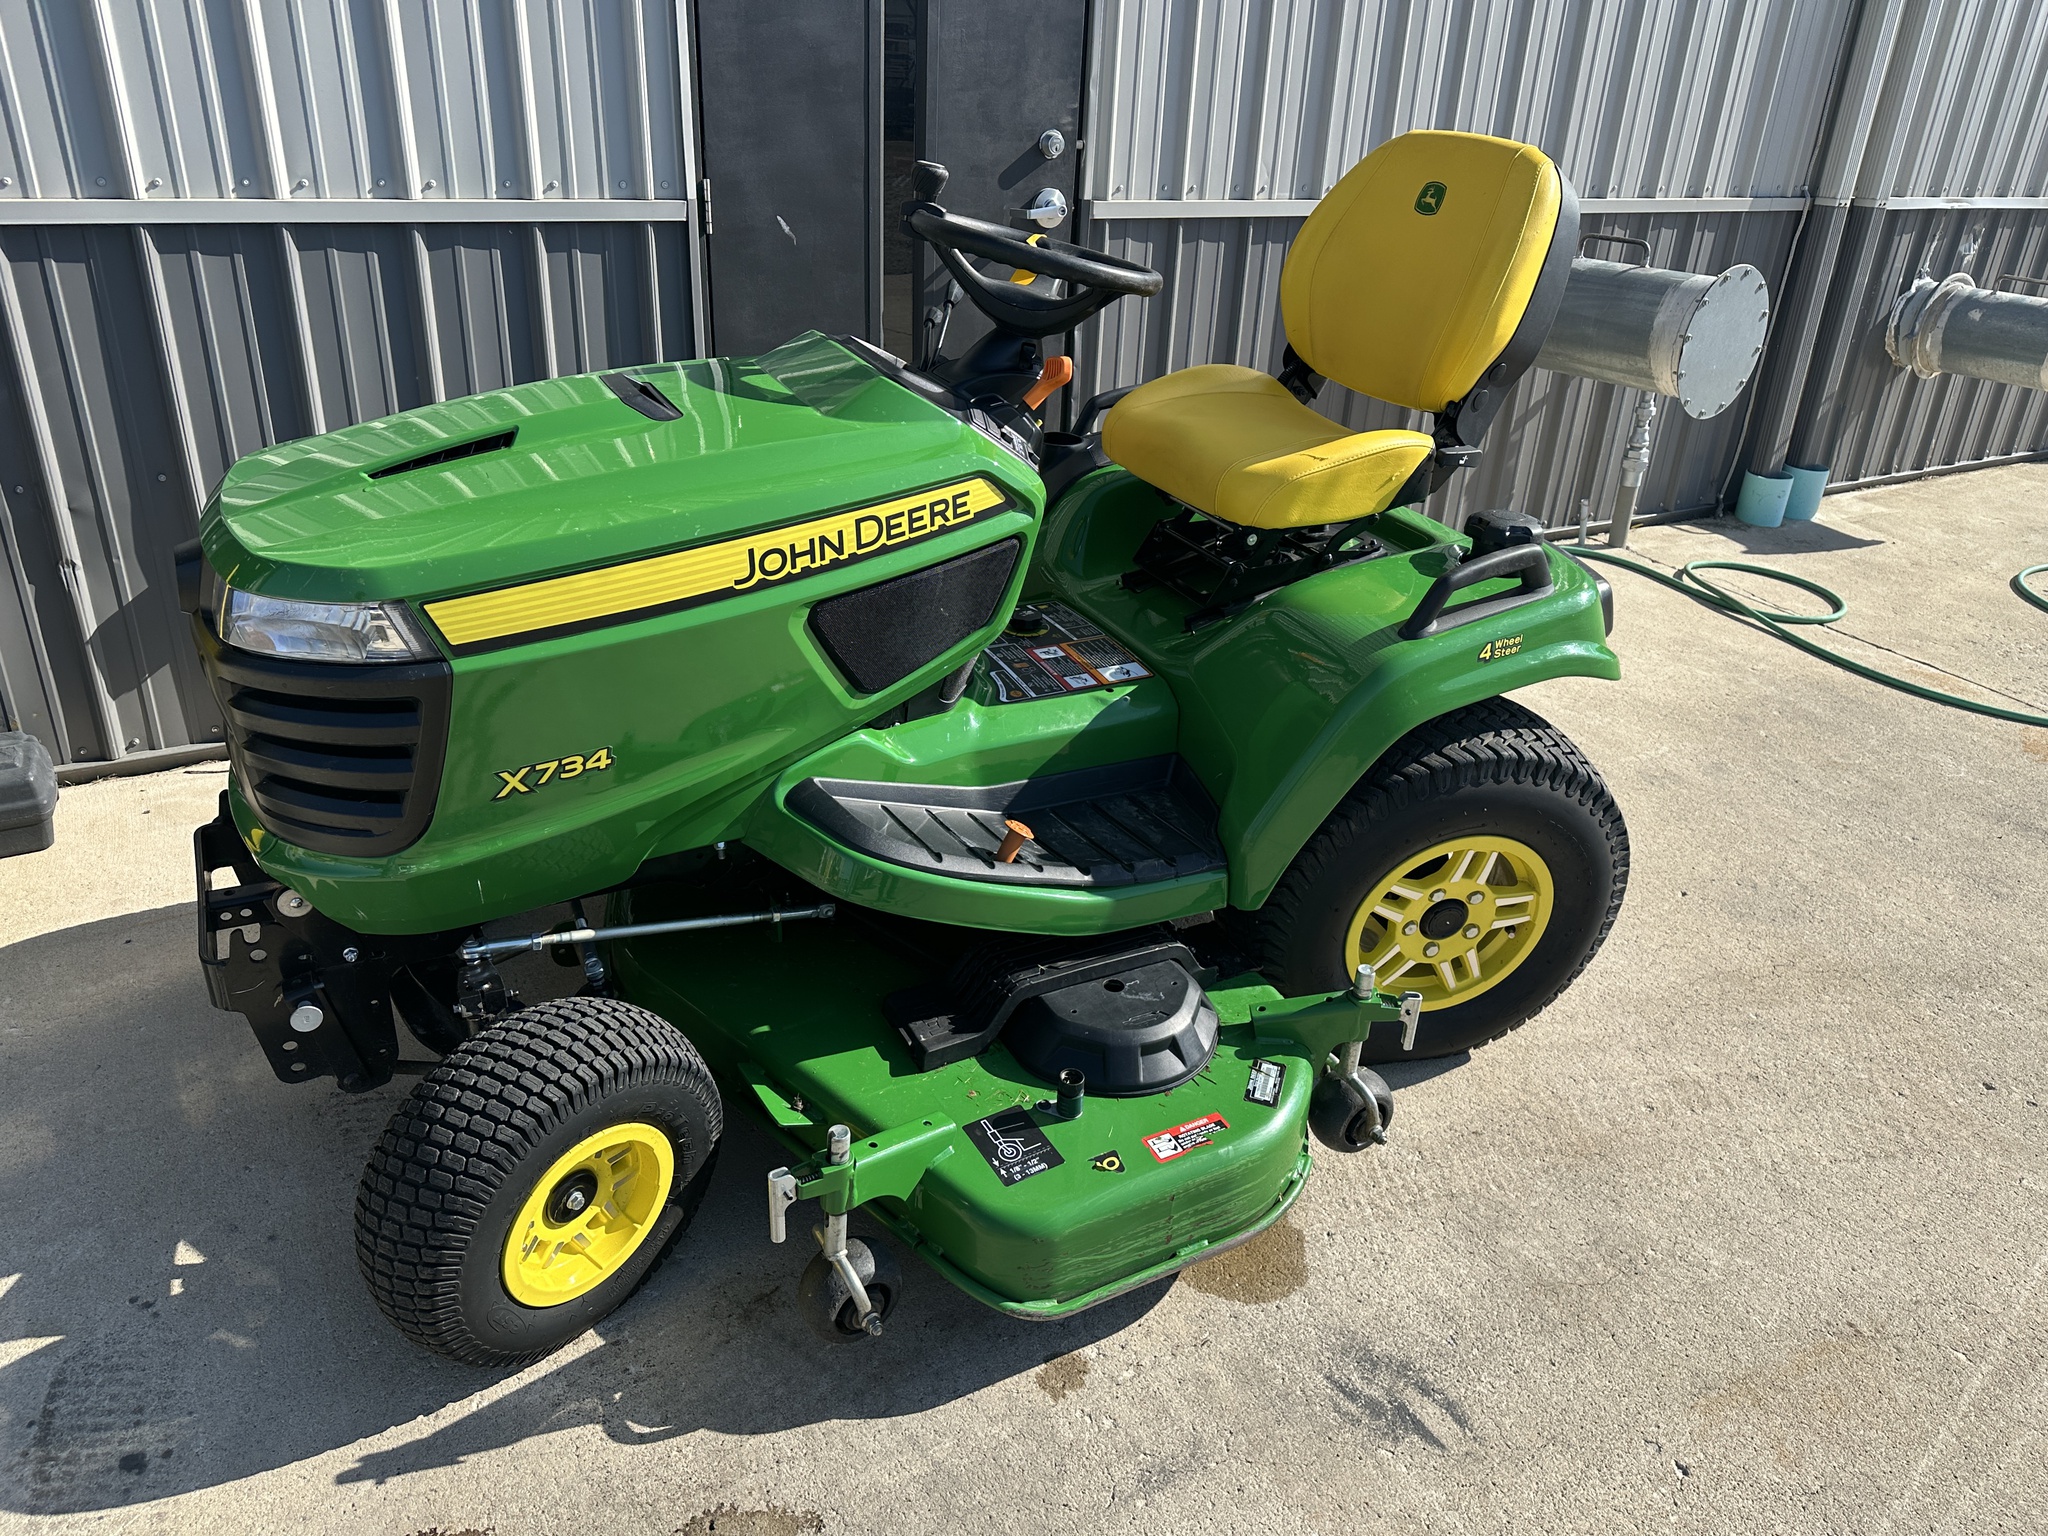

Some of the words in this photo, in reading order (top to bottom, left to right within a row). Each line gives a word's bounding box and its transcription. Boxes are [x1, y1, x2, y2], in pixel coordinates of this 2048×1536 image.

[734, 530, 844, 586] JOHN
[855, 490, 971, 551] DEERE
[1478, 642, 1492, 661] 4
[1495, 633, 1524, 649] Wheel
[1493, 645, 1522, 659] Steer
[493, 747, 613, 800] X734
[1184, 1118, 1209, 1130] DANGER
